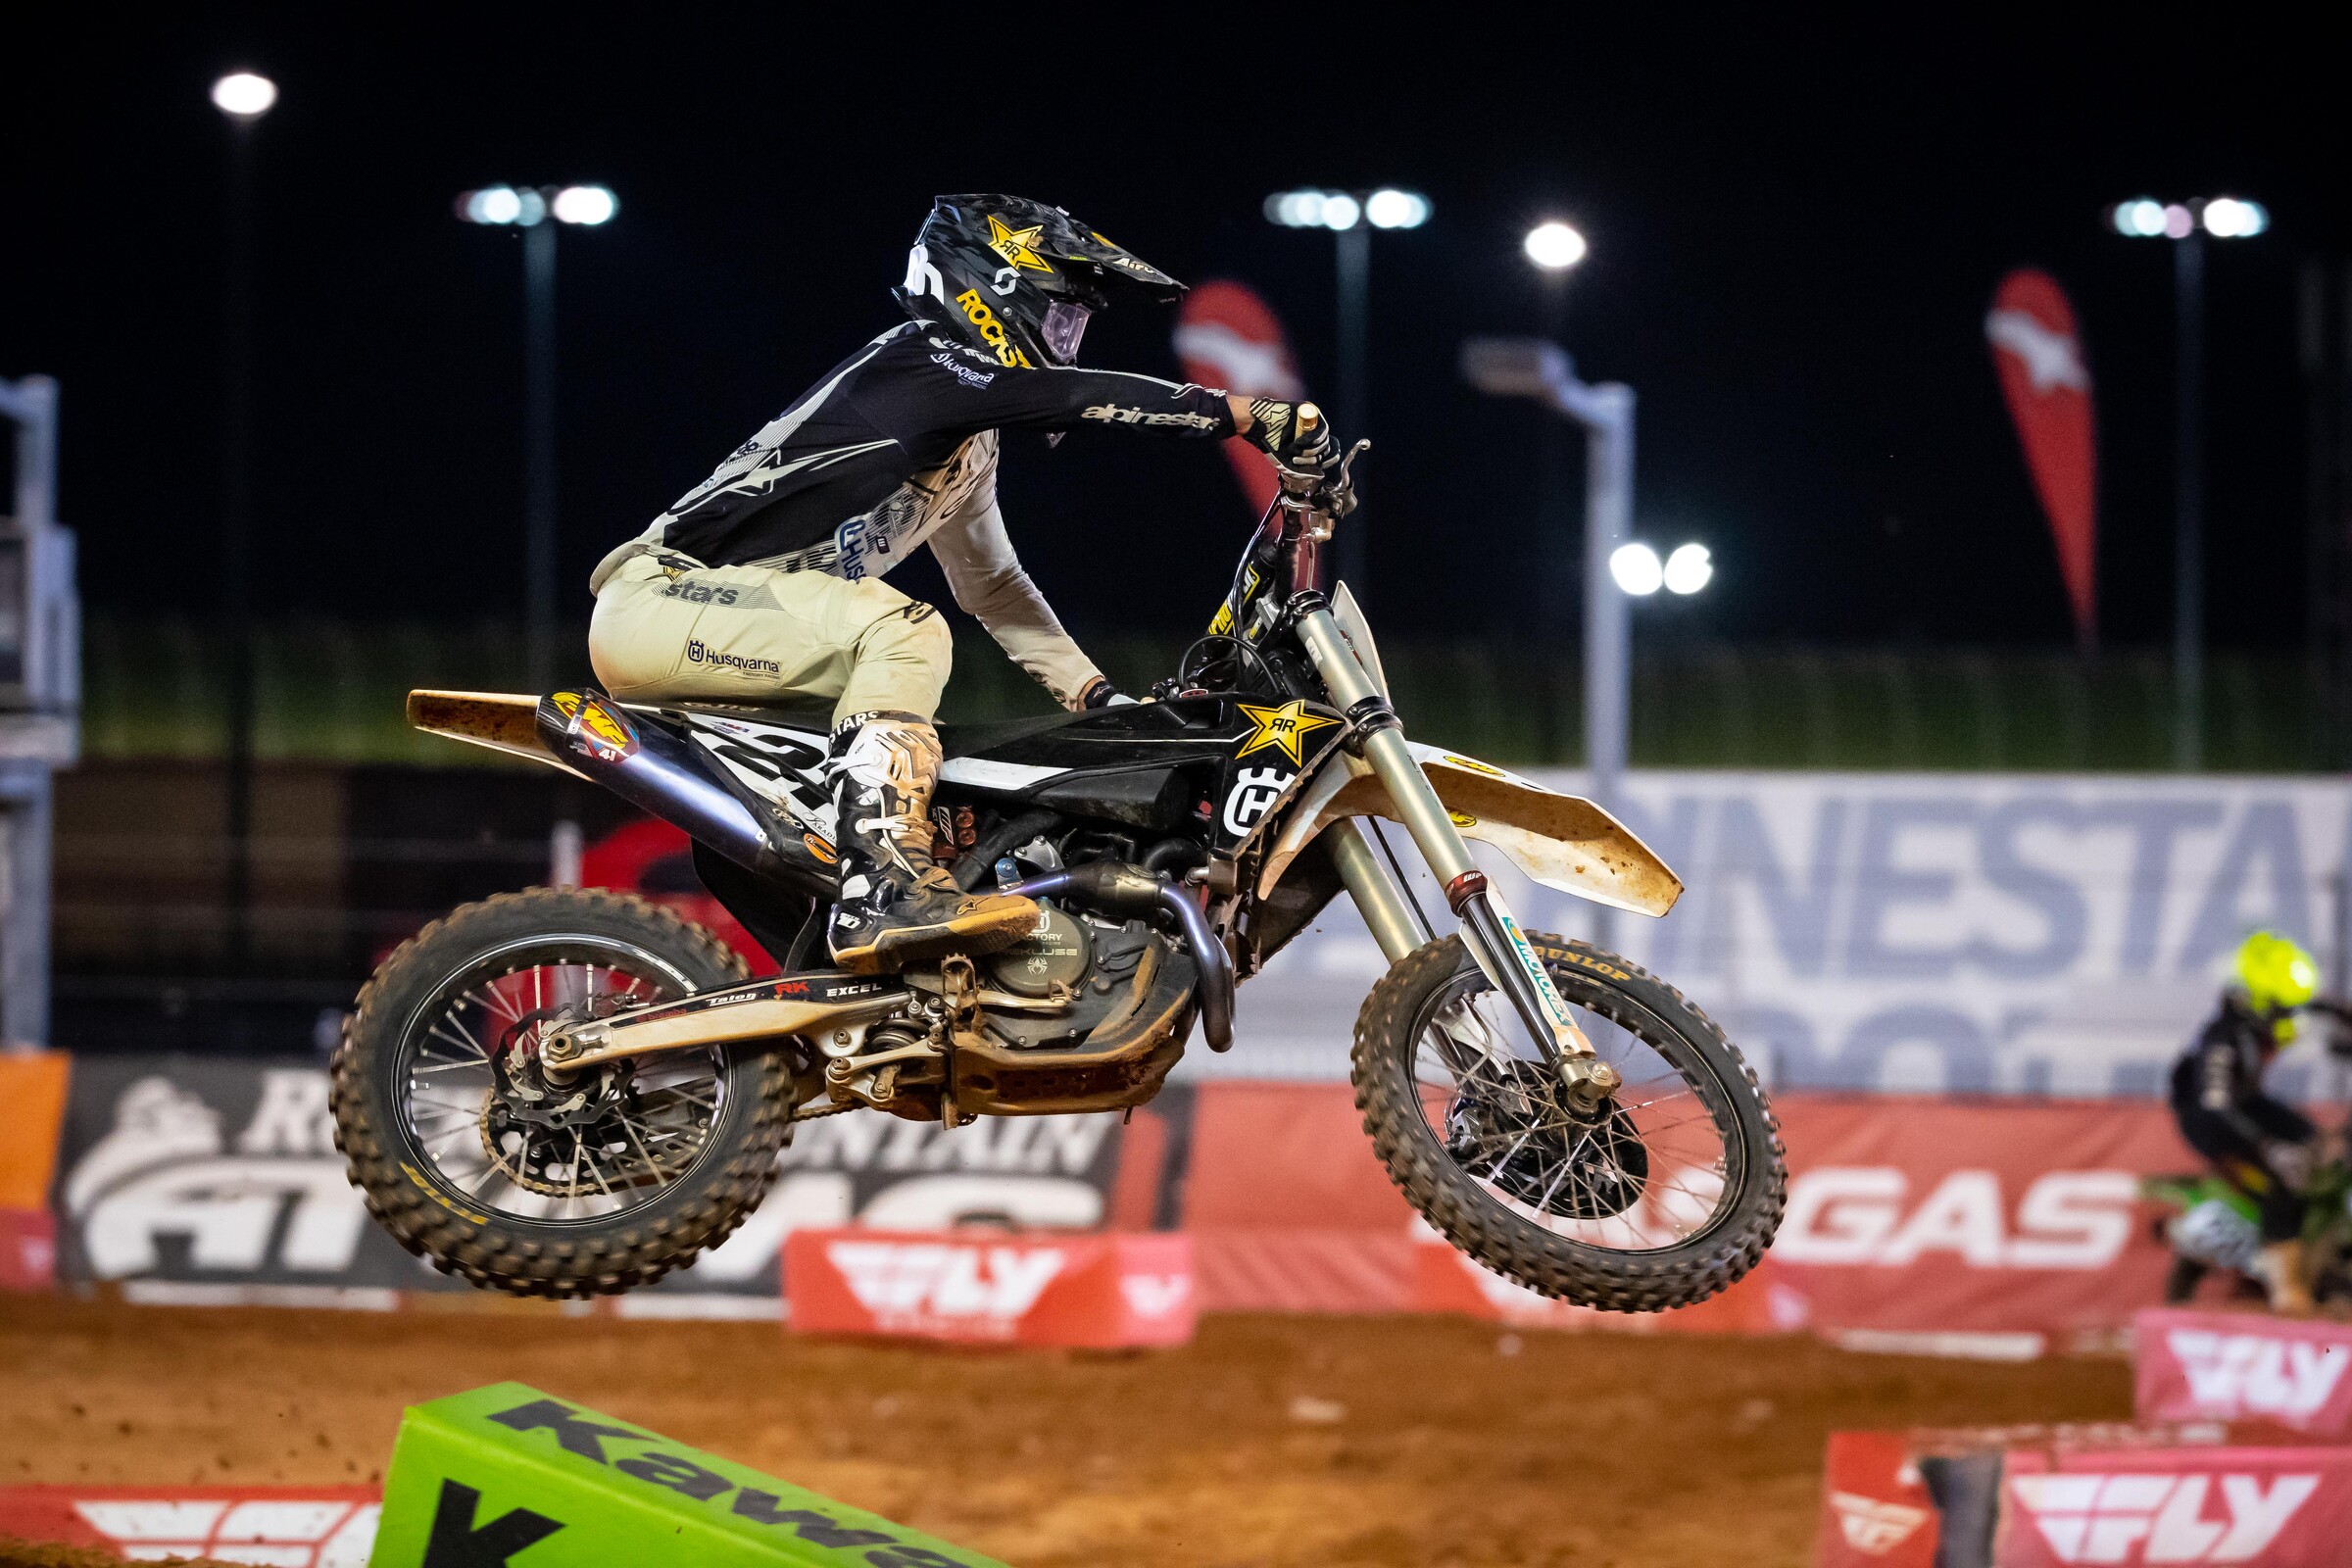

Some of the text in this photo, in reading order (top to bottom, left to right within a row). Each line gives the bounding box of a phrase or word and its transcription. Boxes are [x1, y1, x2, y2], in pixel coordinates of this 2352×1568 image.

[705, 648, 779, 672] Husqvarna
[1652, 799, 2315, 978] INESTA
[1025, 933, 1063, 942] CTORY
[1531, 946, 1632, 982] DUNLOP
[773, 981, 810, 995] RK
[826, 982, 882, 998] EXCEL
[2011, 1474, 2322, 1566] FLY
